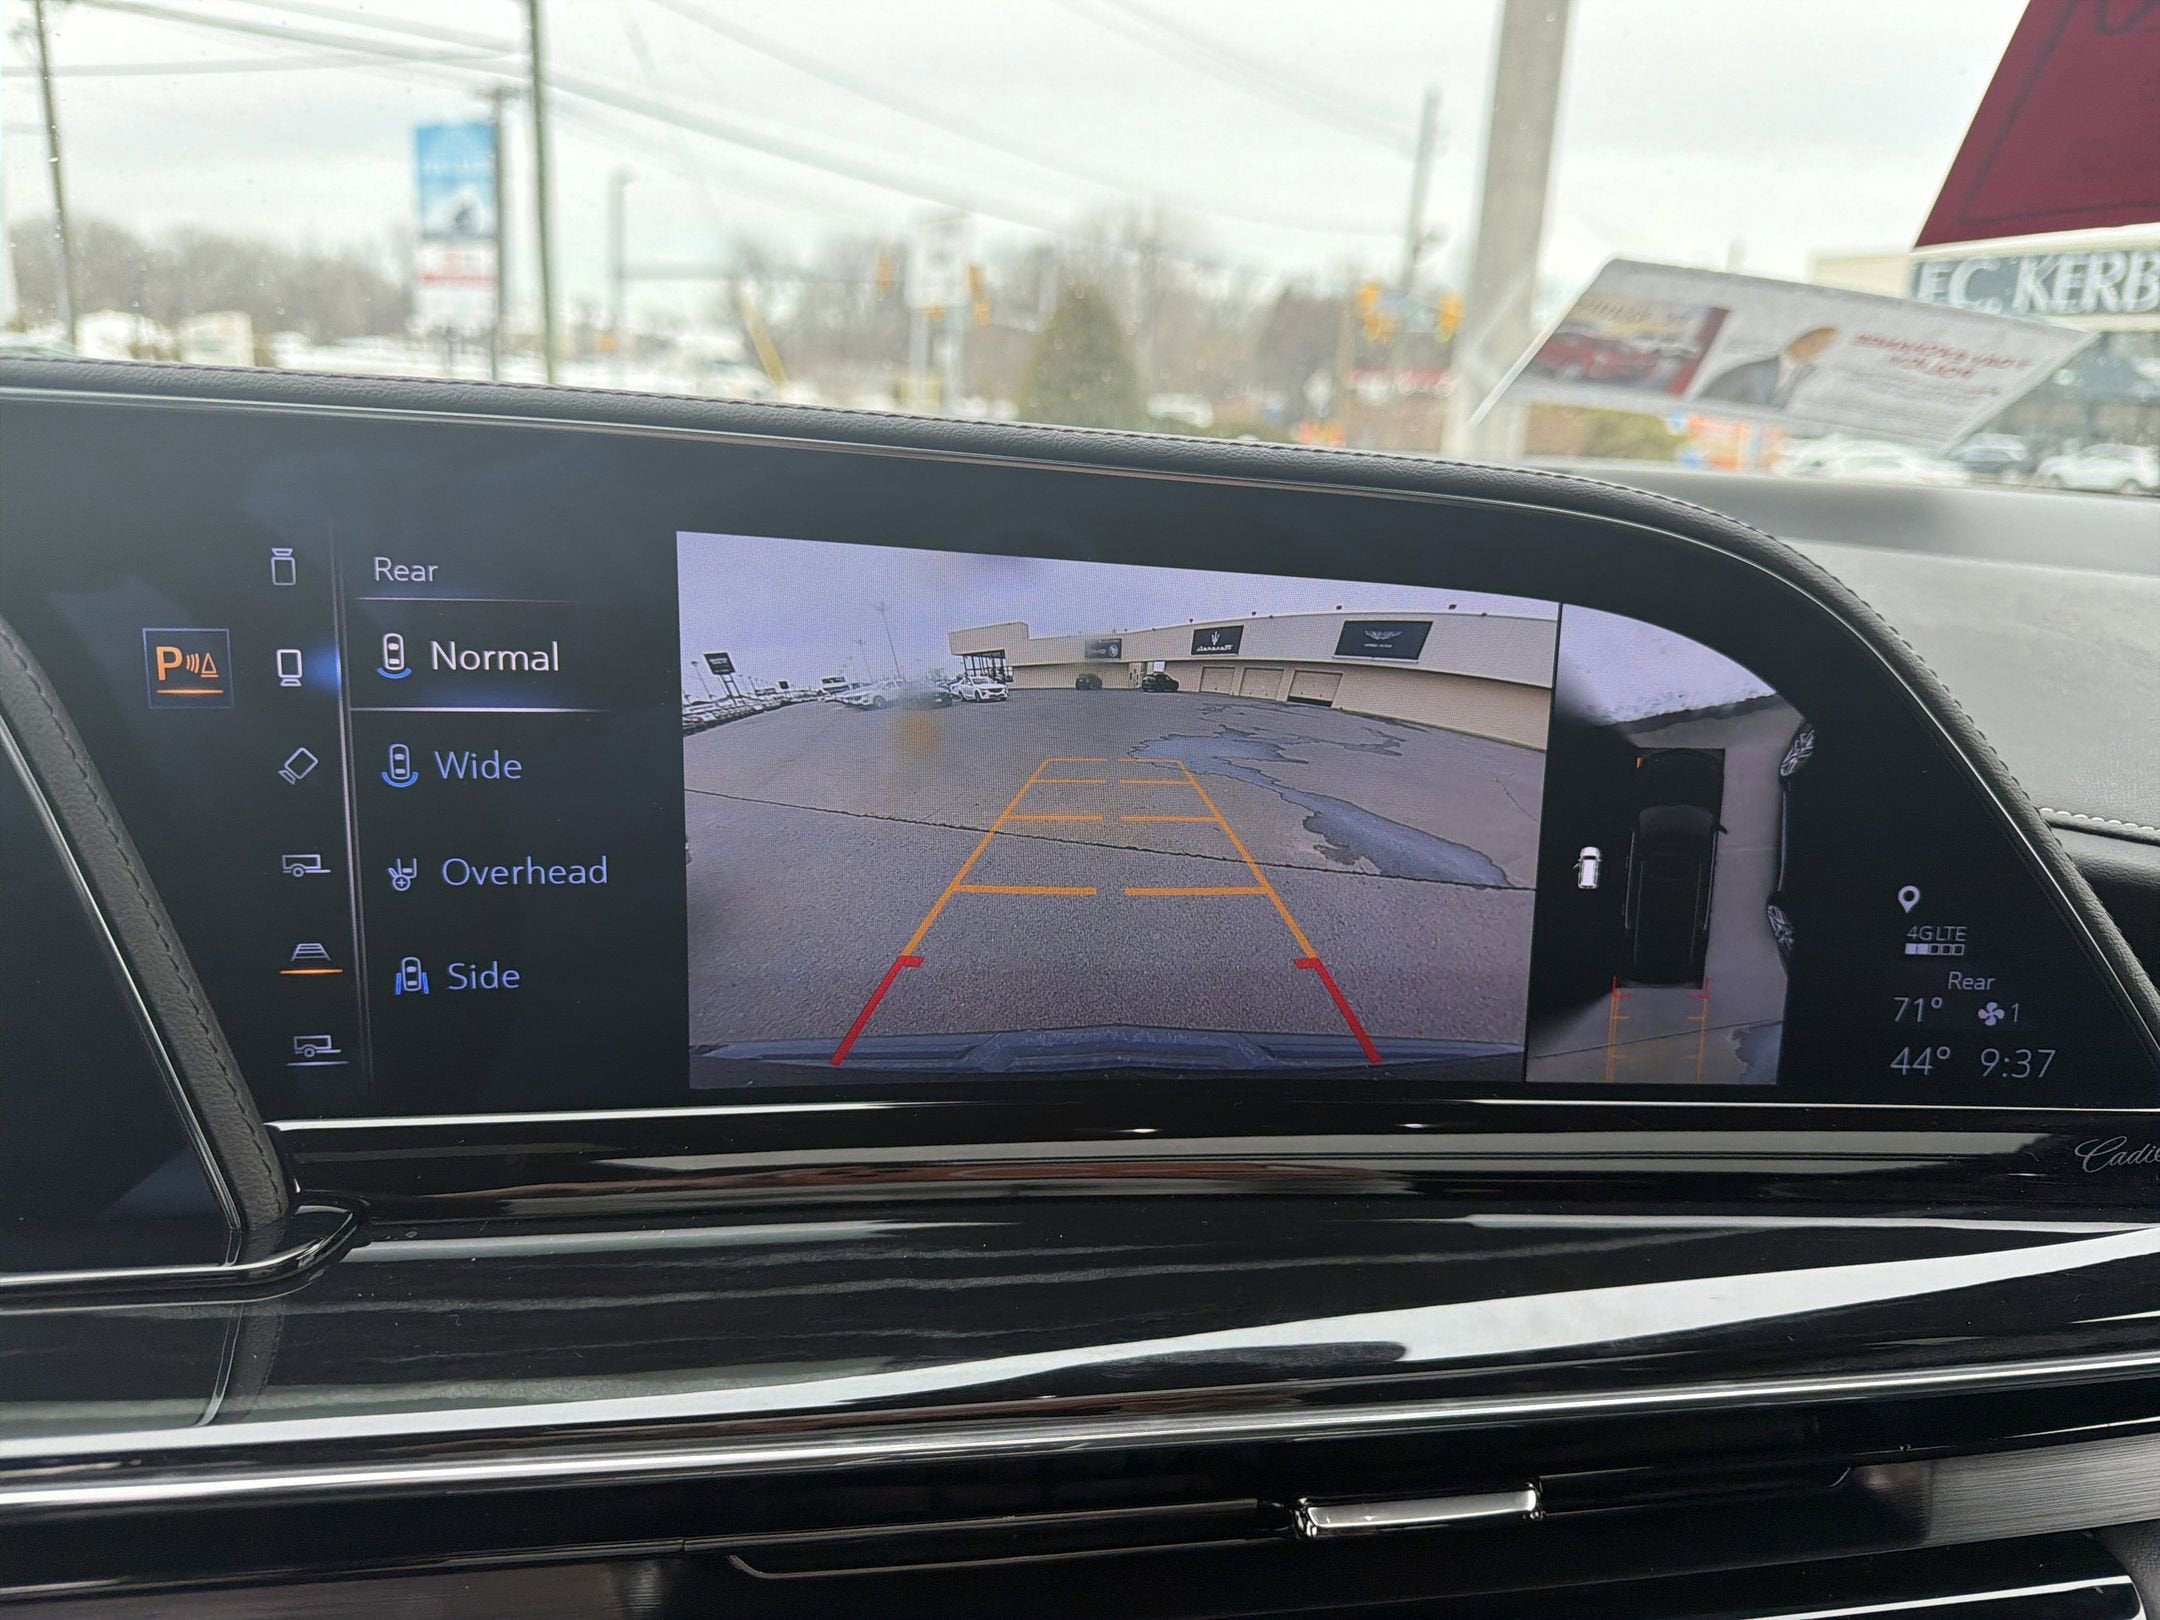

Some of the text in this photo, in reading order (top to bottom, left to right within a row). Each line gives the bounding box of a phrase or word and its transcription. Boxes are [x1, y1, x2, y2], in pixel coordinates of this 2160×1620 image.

[374, 556, 439, 582] Rear
[430, 640, 560, 672] Normal
[434, 749, 523, 780] Wide
[442, 855, 608, 886] Overhead
[447, 960, 521, 990] Side
[1947, 971, 1996, 990] Rear
[1893, 996, 1943, 1023] 71°
[2011, 1002, 2020, 1024] 1
[1889, 1046, 1951, 1076] 44°
[1980, 1048, 2056, 1079] 9:37
